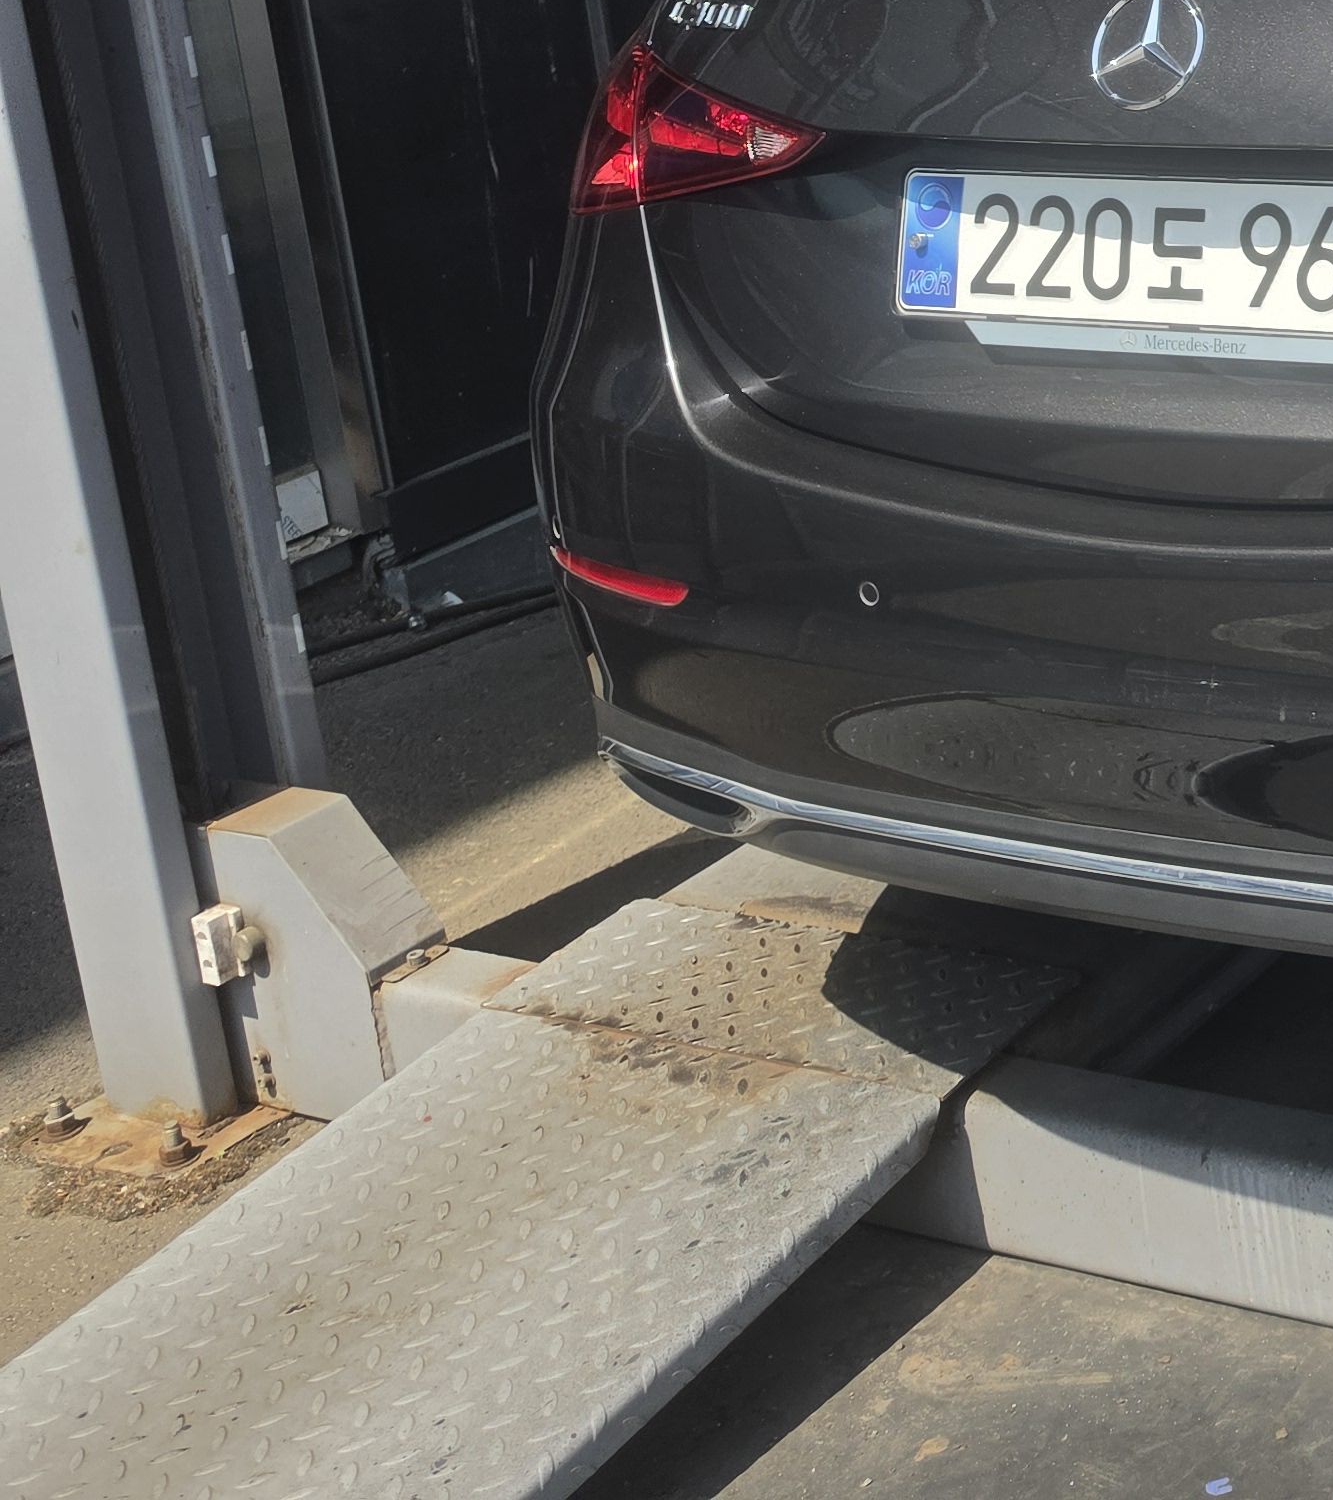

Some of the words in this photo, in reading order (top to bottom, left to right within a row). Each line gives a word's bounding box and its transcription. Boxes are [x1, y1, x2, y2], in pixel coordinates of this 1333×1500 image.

[970, 193, 1206, 302] 220도
[905, 269, 952, 296] KOR
[1143, 334, 1247, 356] Mercedes-Benz
